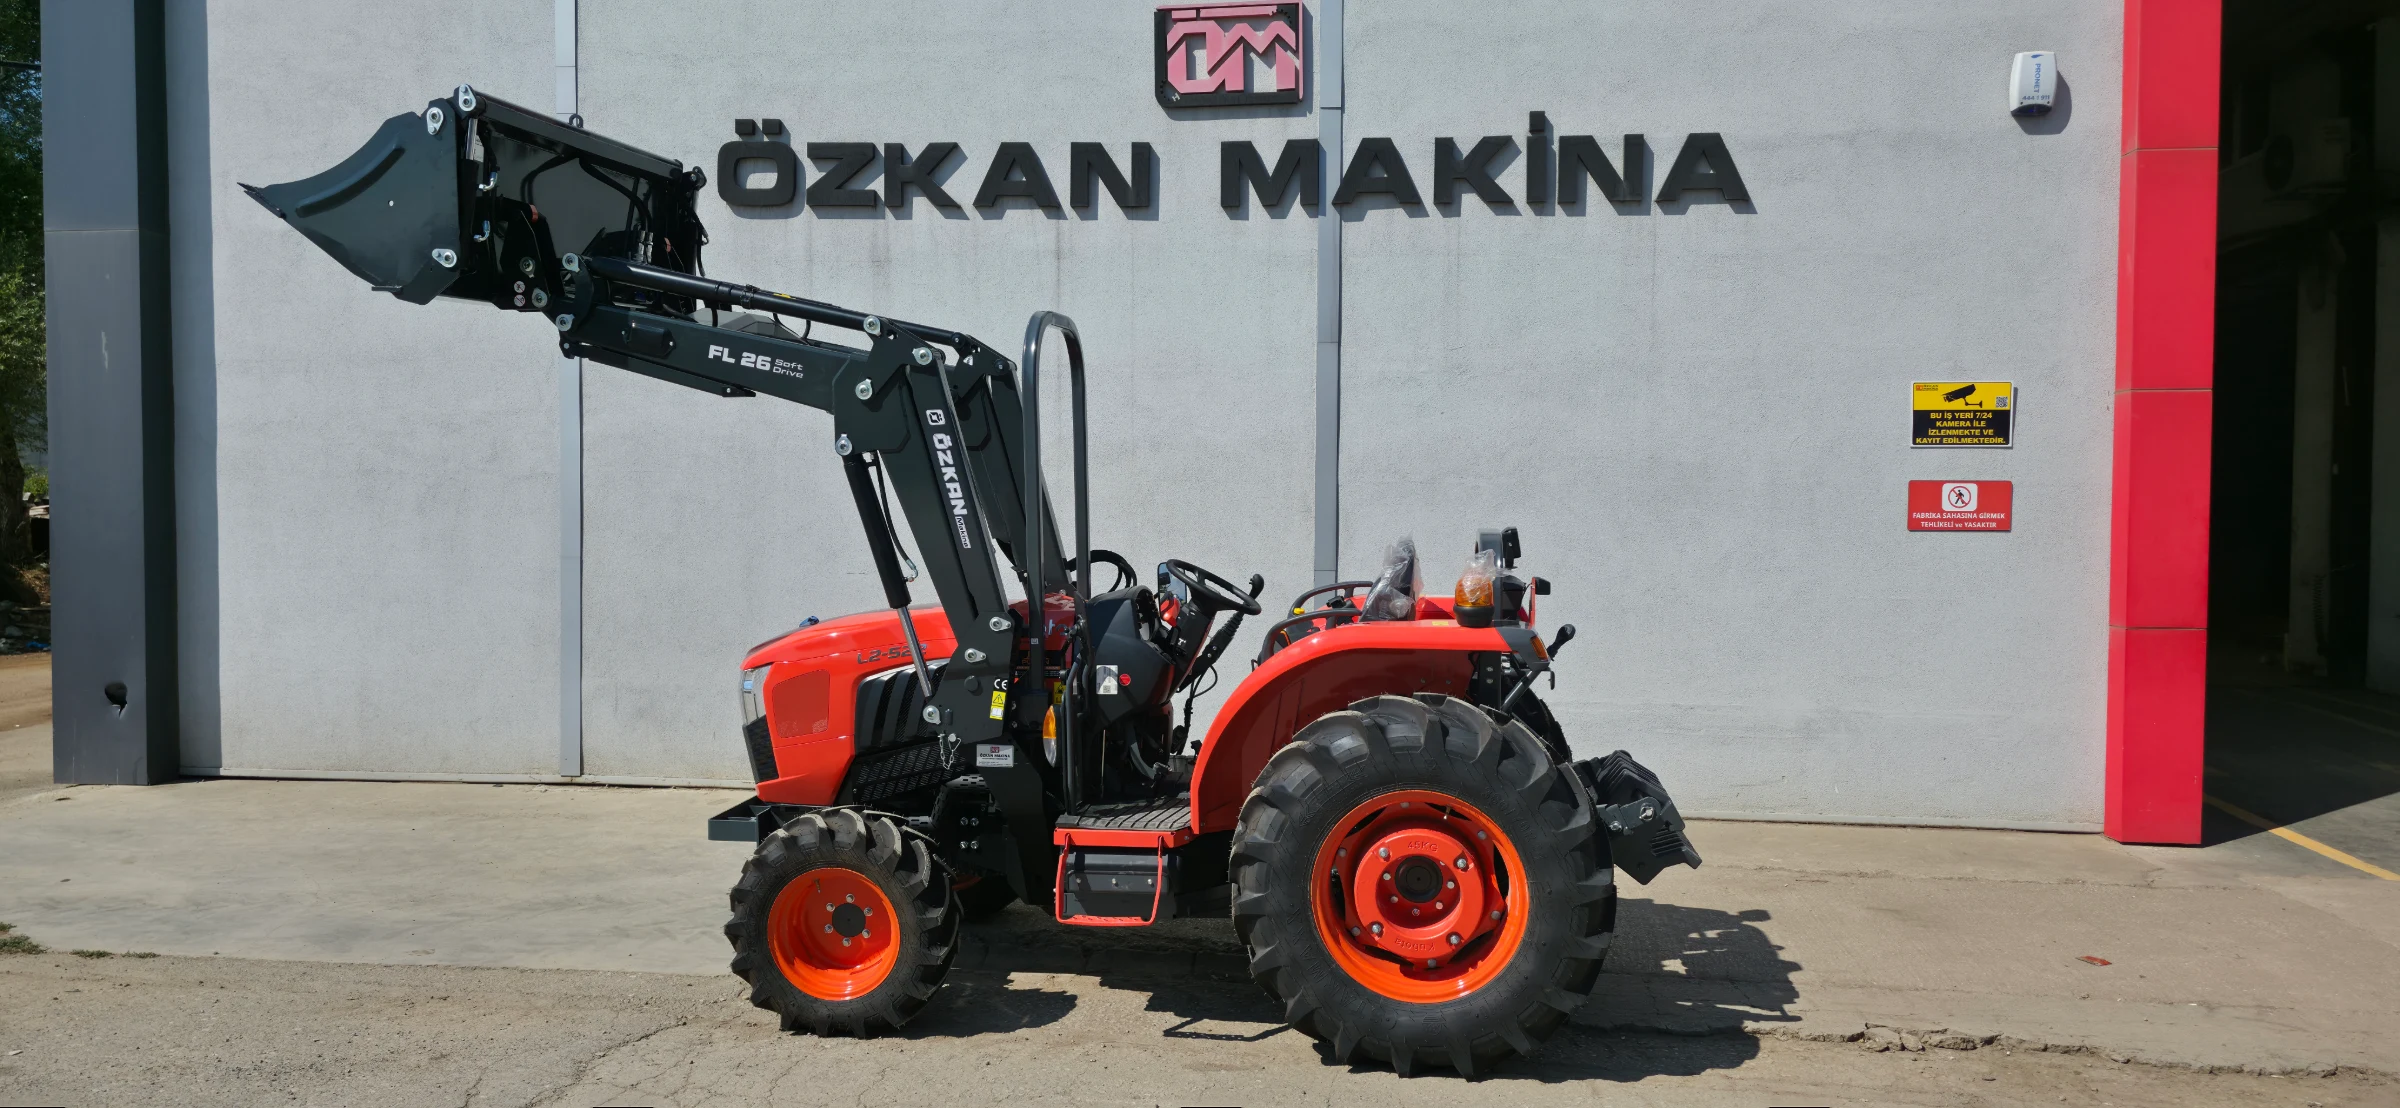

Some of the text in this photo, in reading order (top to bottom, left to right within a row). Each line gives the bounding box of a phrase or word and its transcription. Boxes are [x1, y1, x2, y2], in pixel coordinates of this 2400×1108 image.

[2034, 63, 2042, 93] PRONET
[717, 110, 1750, 208] ÖZKAN MAKİNA
[708, 344, 772, 371] FL 26
[774, 358, 804, 371] Soft
[772, 366, 804, 379] Drive
[1944, 411, 1952, 420] İŞ
[1954, 411, 1974, 419] YERİ
[1973, 419, 1986, 427] İLE
[1928, 428, 1981, 436] İZLENMEKTE
[1942, 436, 2006, 444] EDİLMEKTEDİR.
[932, 433, 968, 516] ÖZKAN
[1912, 511, 1941, 519] FABRİKA
[1979, 511, 2005, 519] GİRMEK
[1921, 520, 1954, 528] TEHLİKELİ
[956, 517, 970, 548] Makina
[993, 678, 1008, 691] CE
[1407, 840, 1440, 853] 45KG
